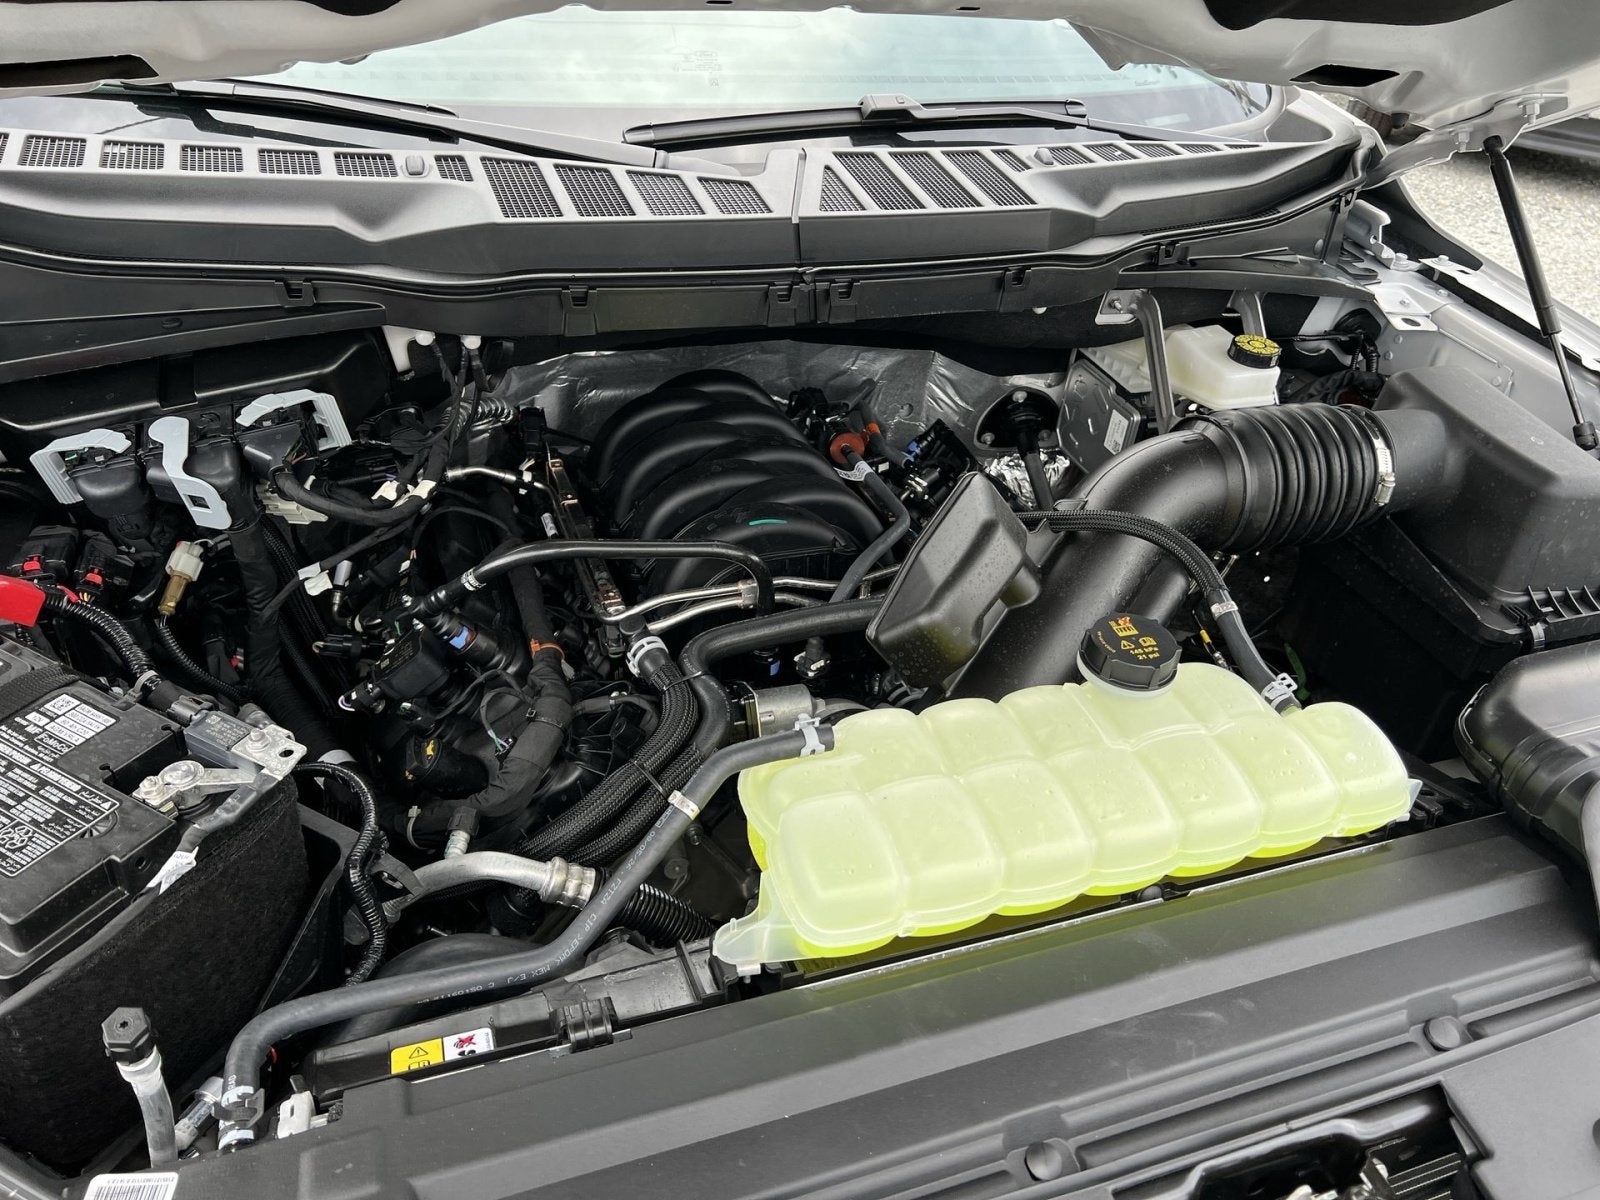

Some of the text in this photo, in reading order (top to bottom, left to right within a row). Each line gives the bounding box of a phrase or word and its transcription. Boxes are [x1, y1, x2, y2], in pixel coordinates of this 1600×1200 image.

[38, 732, 70, 752] FoMoCo
[584, 913, 597, 932] CIP
[532, 964, 551, 977] MEX
